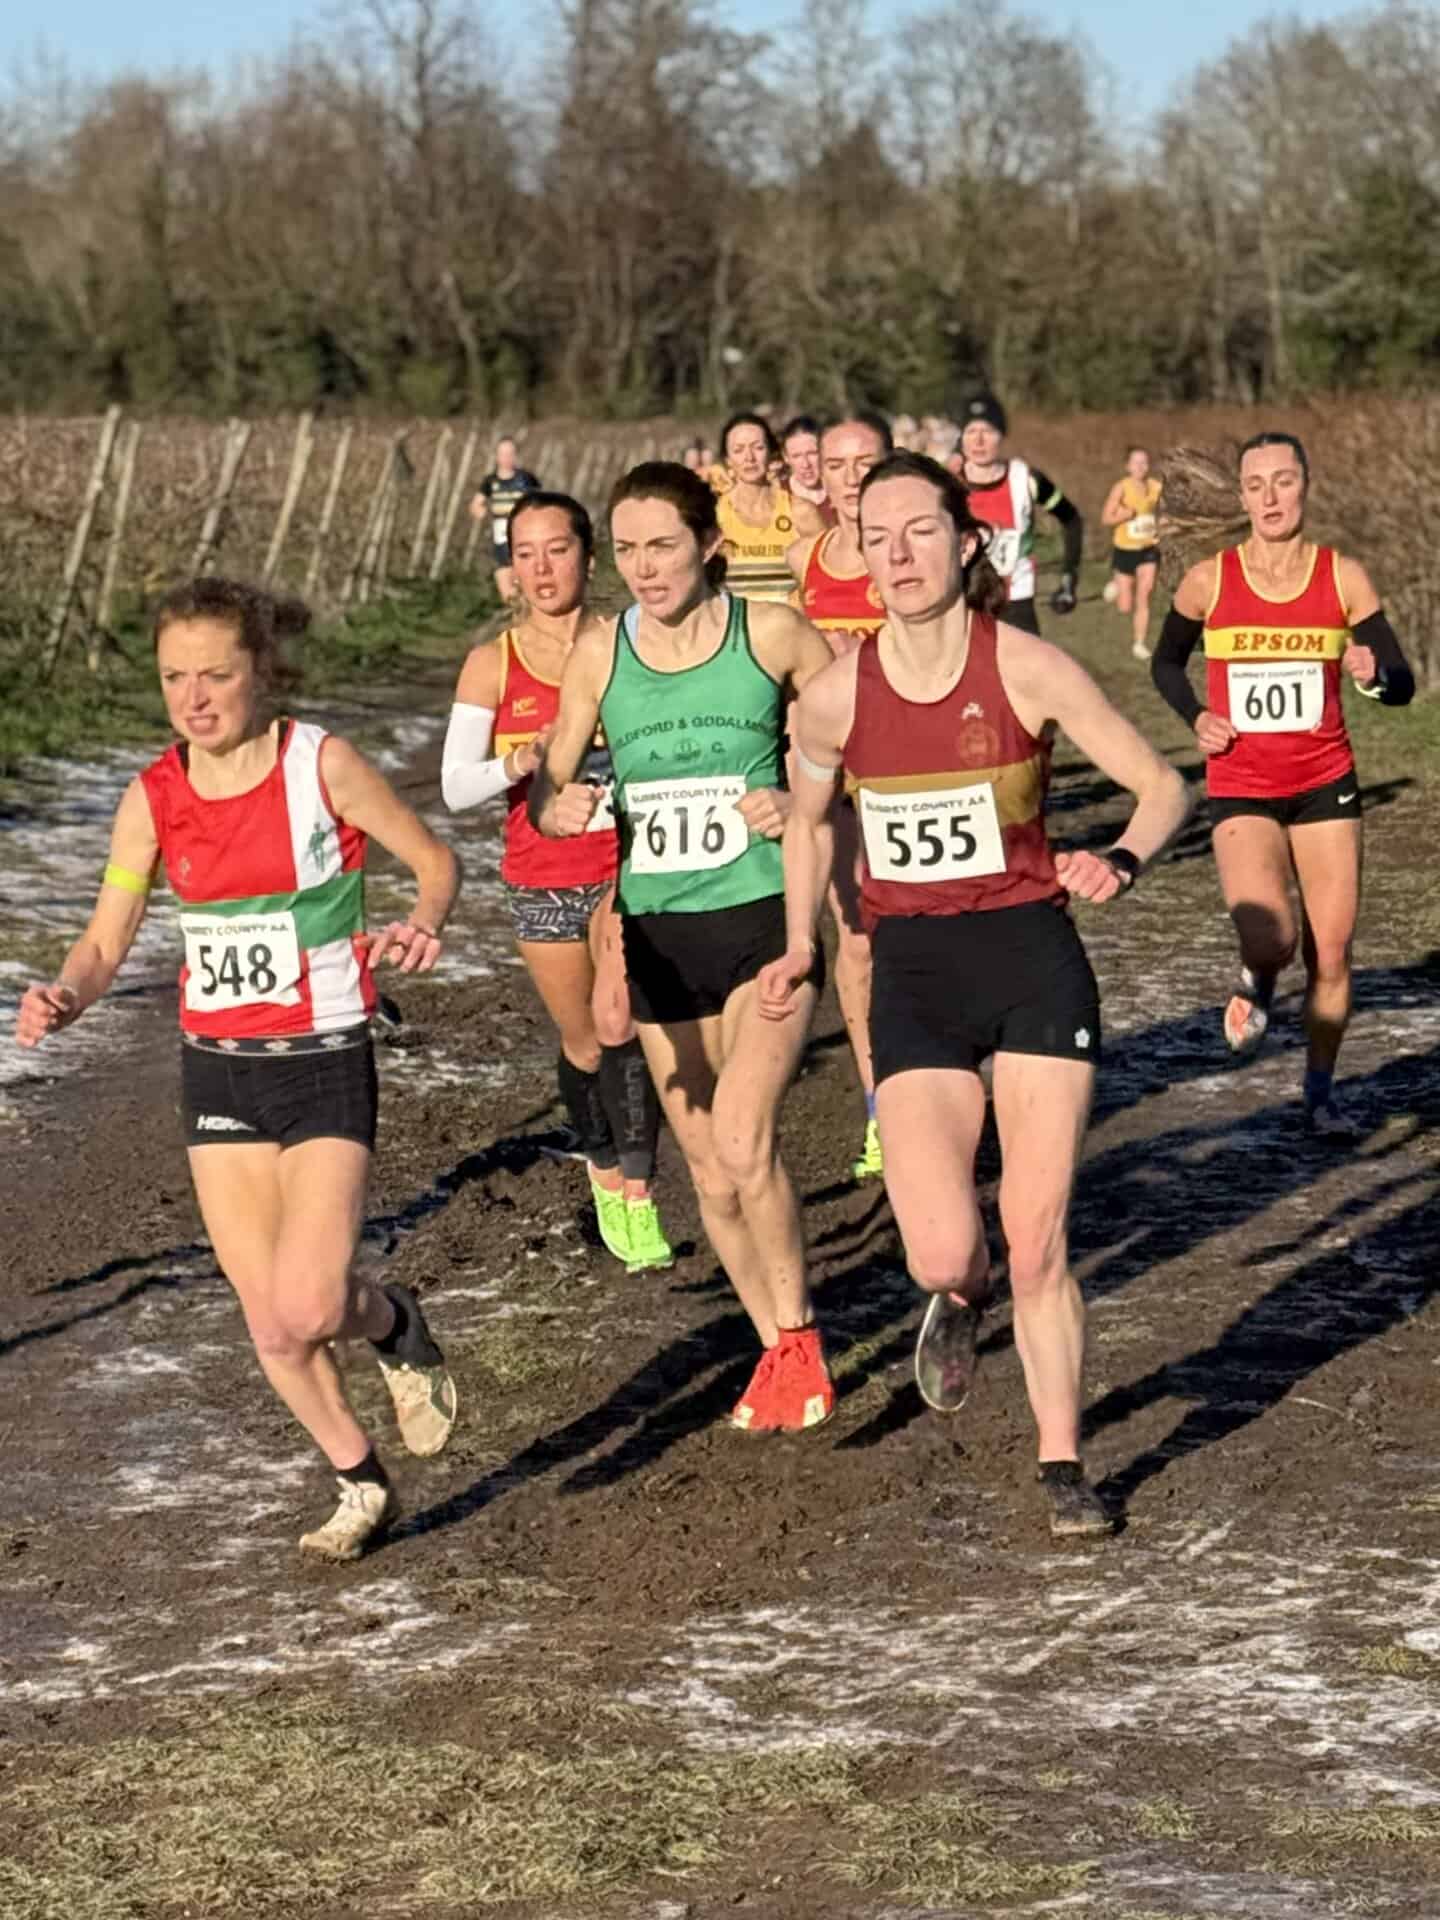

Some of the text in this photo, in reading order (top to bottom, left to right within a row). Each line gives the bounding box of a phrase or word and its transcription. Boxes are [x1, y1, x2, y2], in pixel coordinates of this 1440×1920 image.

[1232, 632, 1325, 652] EPSOM
[1245, 682, 1303, 721] 601
[646, 805, 726, 857] 616
[886, 814, 977, 867] 555
[199, 943, 278, 997] 548
